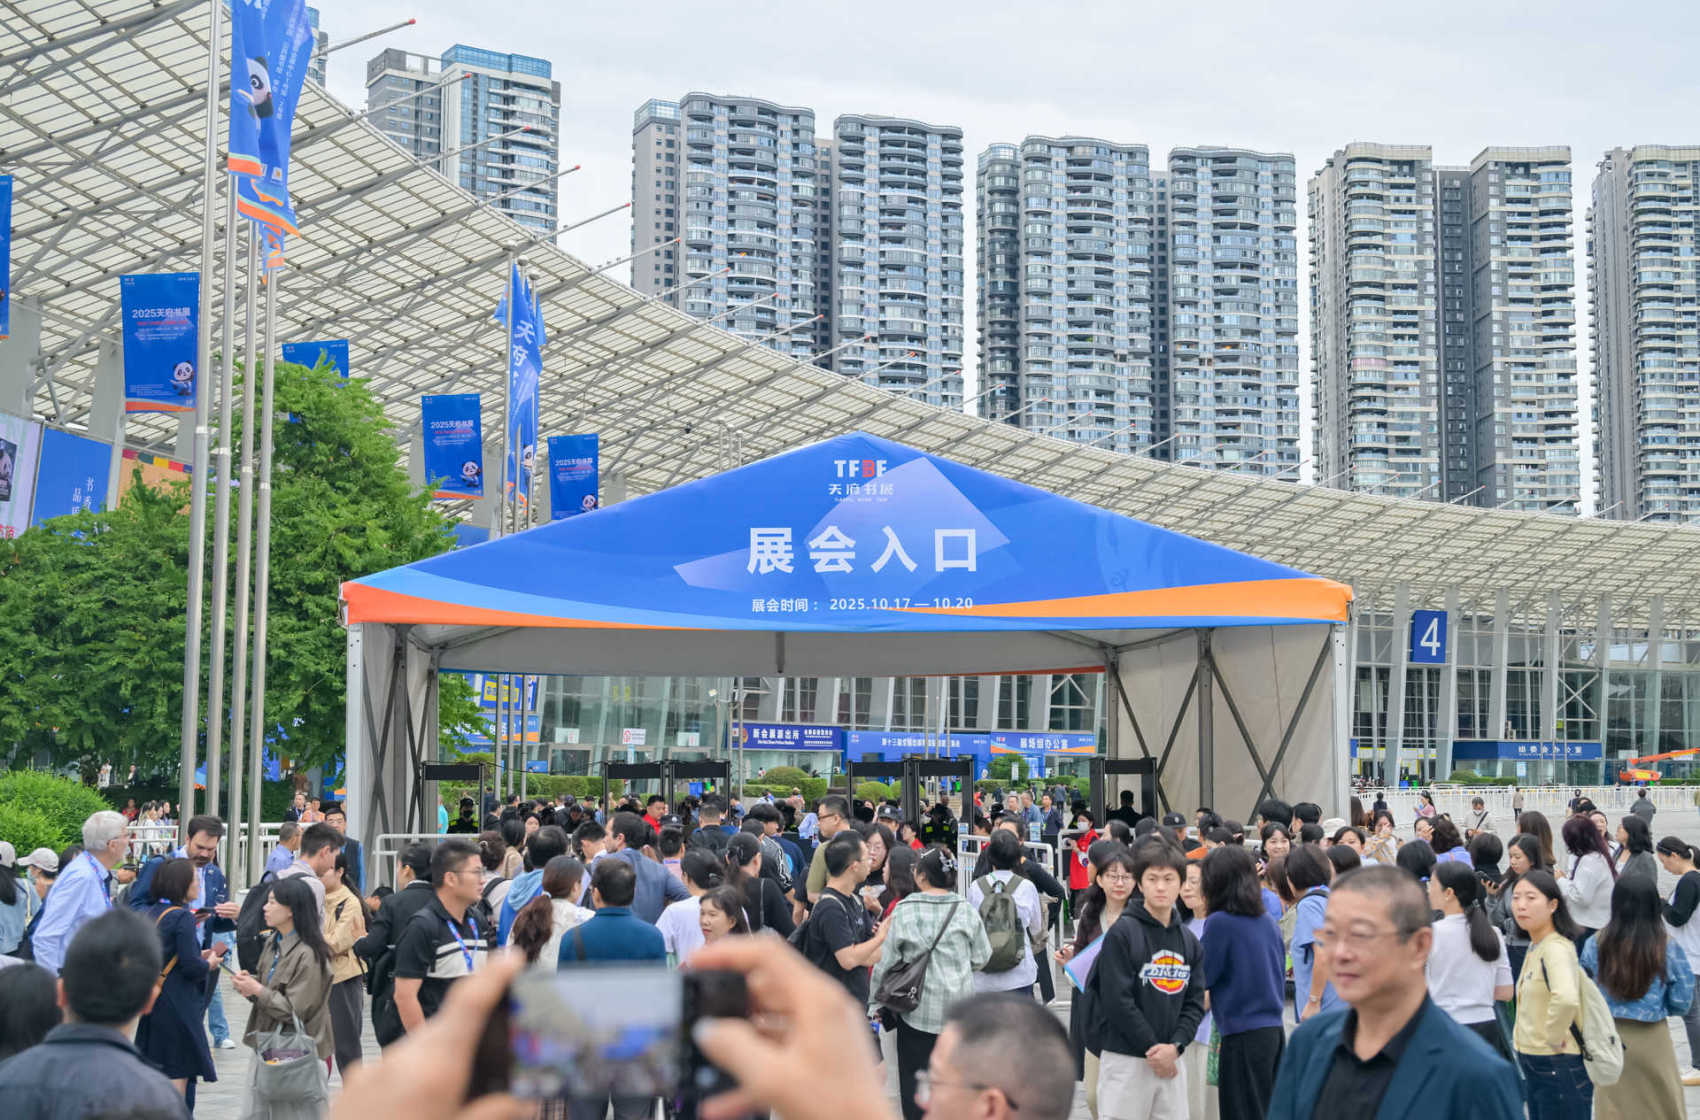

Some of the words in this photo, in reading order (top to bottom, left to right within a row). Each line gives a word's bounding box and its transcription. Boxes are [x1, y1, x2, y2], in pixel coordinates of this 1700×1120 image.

[834, 459, 887, 478] TFBF
[828, 483, 895, 496] 天府书展
[747, 525, 977, 575] 展会入口
[1420, 617, 1441, 656] 4
